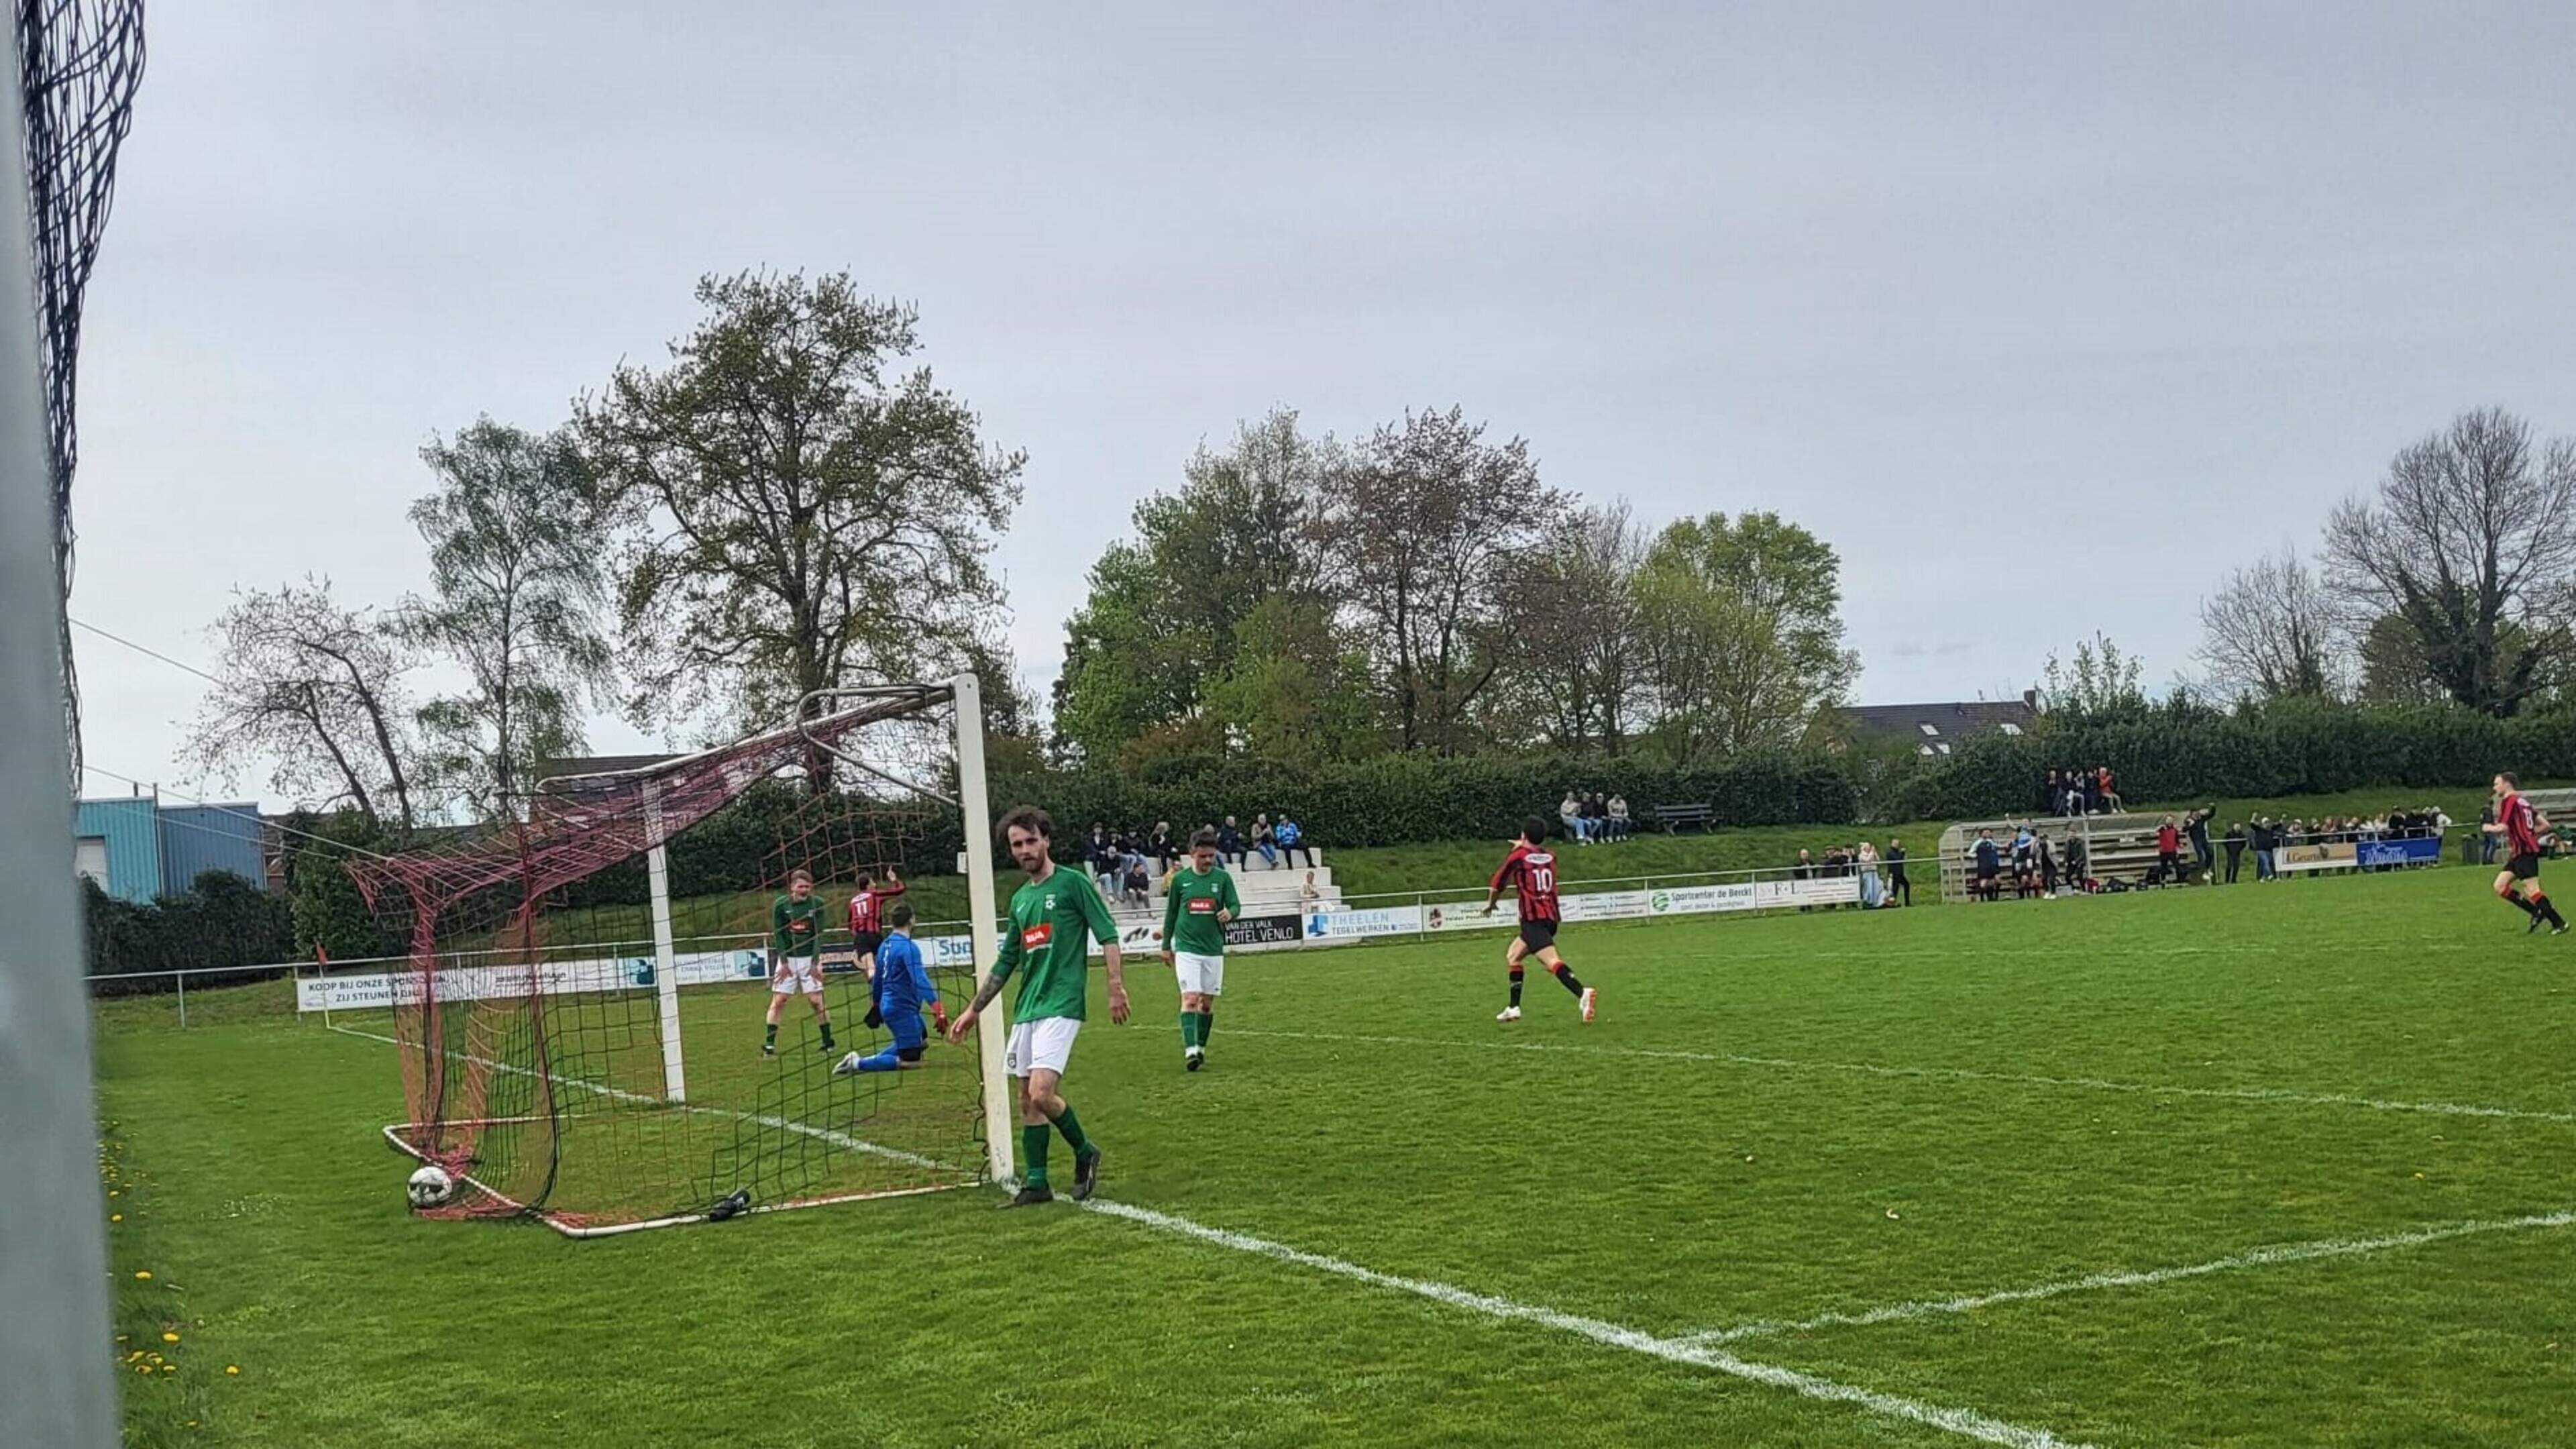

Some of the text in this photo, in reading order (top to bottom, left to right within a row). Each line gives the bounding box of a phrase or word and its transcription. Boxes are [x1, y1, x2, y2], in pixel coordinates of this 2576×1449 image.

[1532, 868, 1552, 893] 10
[1671, 890, 1715, 902] Sportcenter
[1717, 889, 1727, 898] de
[1224, 919, 1273, 930] VAN DER VALK
[1332, 912, 1389, 925] THEELEN
[1224, 926, 1294, 945] HOTEL VENLO
[1332, 924, 1389, 936] TEGELWERKEN
[309, 981, 337, 991] KOOP
[339, 981, 354, 989] BIJ
[356, 979, 382, 988] ONZE
[336, 994, 350, 1002] ZIJ
